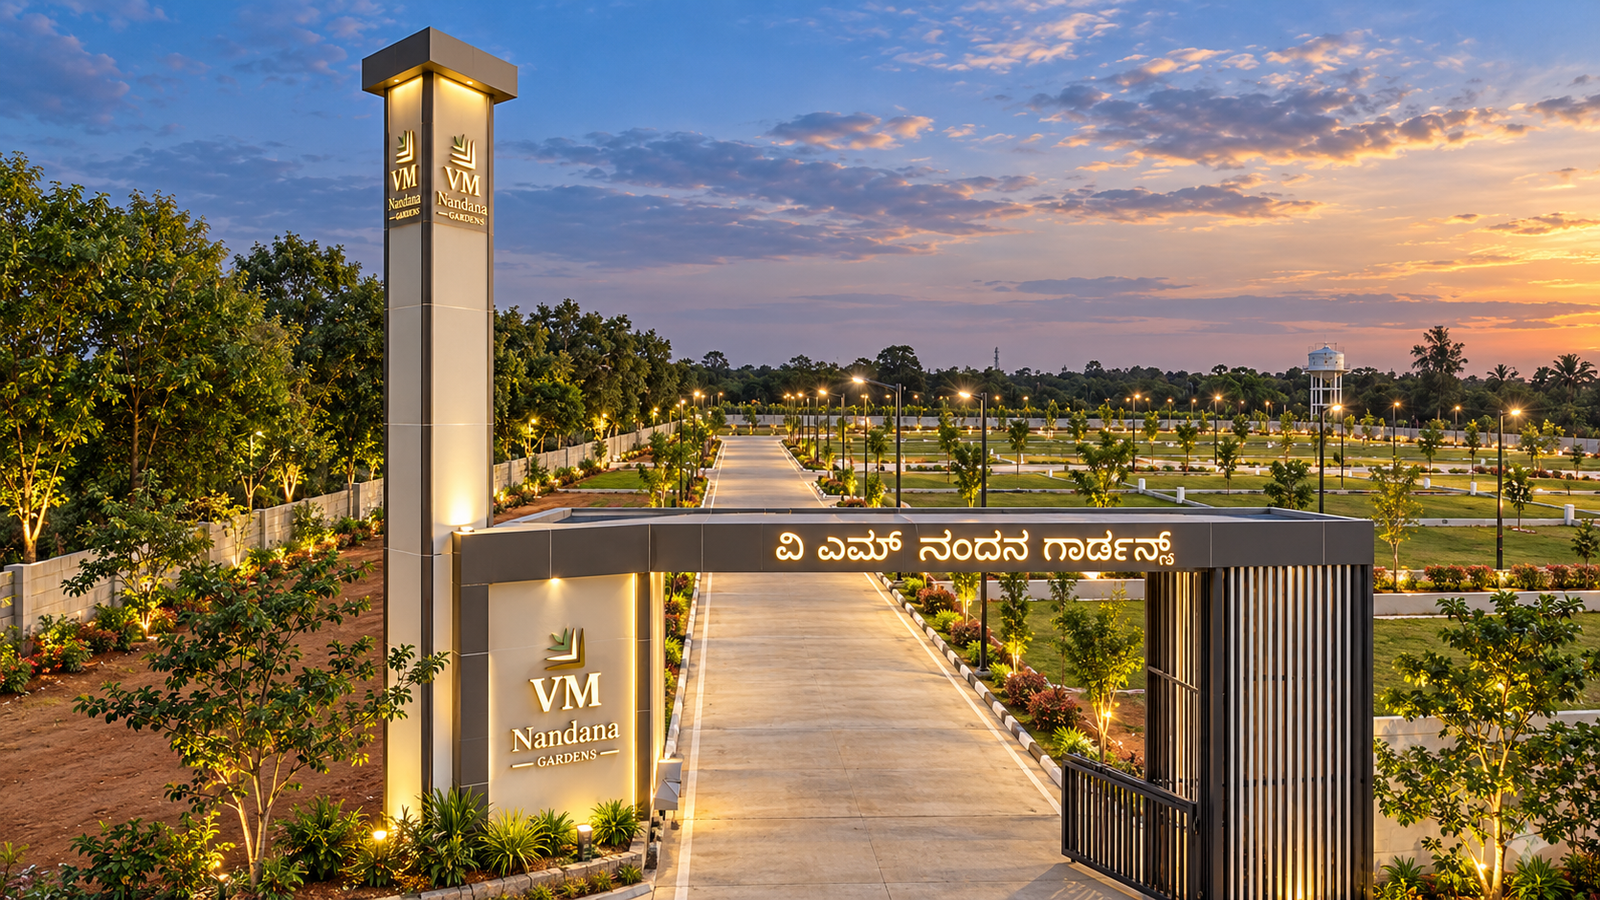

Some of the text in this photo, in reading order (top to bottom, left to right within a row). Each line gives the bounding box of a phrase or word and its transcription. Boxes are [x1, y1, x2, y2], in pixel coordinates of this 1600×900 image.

[391, 164, 418, 192] VM
[444, 165, 481, 197] VM
[388, 194, 422, 211] Nandana
[437, 190, 488, 216] Nandana
[448, 211, 485, 226] GARDENS
[775, 531, 804, 561] ವಿ
[817, 529, 903, 561] ಎಮ್
[919, 529, 1030, 561] ನಂದನ
[529, 672, 602, 713] VM
[511, 720, 620, 752] Nandana
[537, 749, 597, 767] GARDENS
